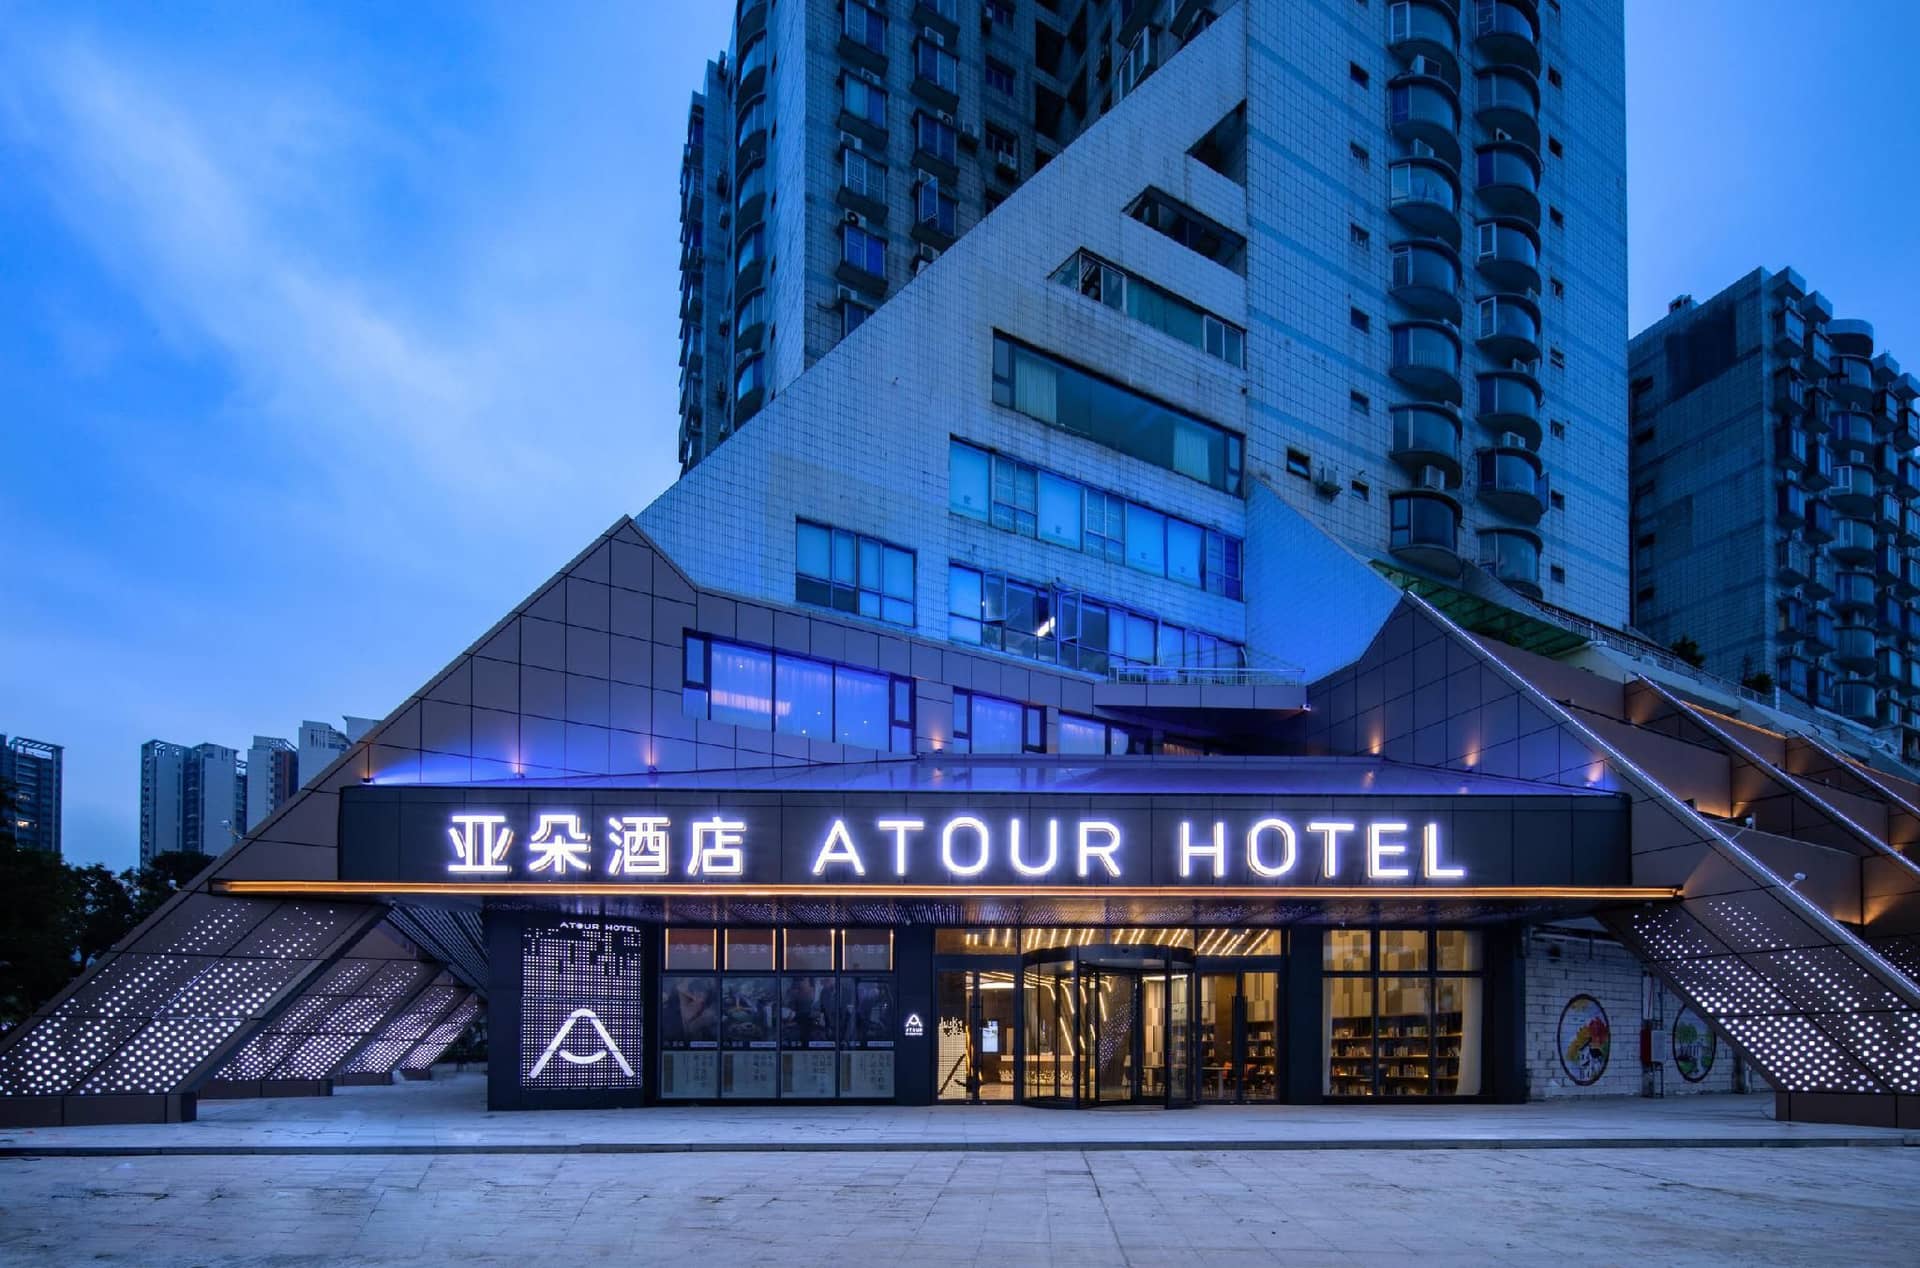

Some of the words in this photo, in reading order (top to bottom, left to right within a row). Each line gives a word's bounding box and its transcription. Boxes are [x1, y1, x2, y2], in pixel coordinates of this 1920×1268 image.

[447, 814, 748, 877] 亚朵酒店
[811, 815, 1123, 878] ATOUR
[1178, 817, 1466, 880] HOTEL
[560, 921, 600, 930] ATOUR
[604, 924, 641, 933] HOTEL
